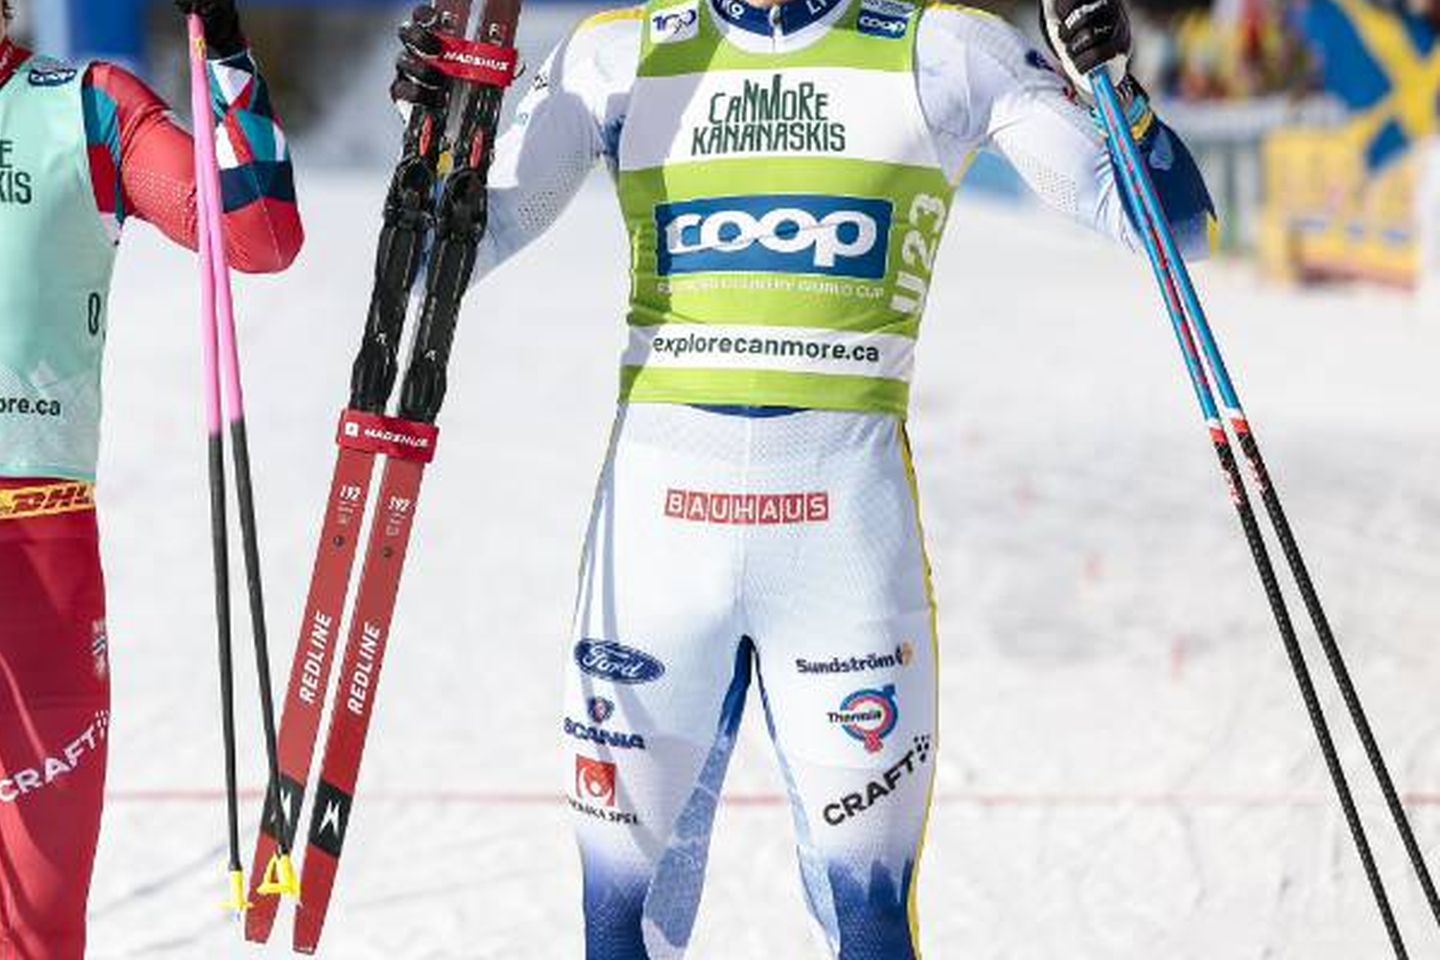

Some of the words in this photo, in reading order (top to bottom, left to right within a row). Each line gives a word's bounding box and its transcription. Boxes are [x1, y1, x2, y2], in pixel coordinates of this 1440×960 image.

[691, 122, 846, 156] KANANASKIS
[666, 207, 878, 268] coop
[653, 332, 880, 363] explorecanmore.ca
[667, 492, 827, 522] BAUHAUS
[299, 611, 333, 704] REDLINE
[347, 621, 381, 715] REDLINE
[580, 648, 648, 680] Ford
[564, 717, 646, 751] SCANIA
[823, 750, 914, 826] CRAFT
